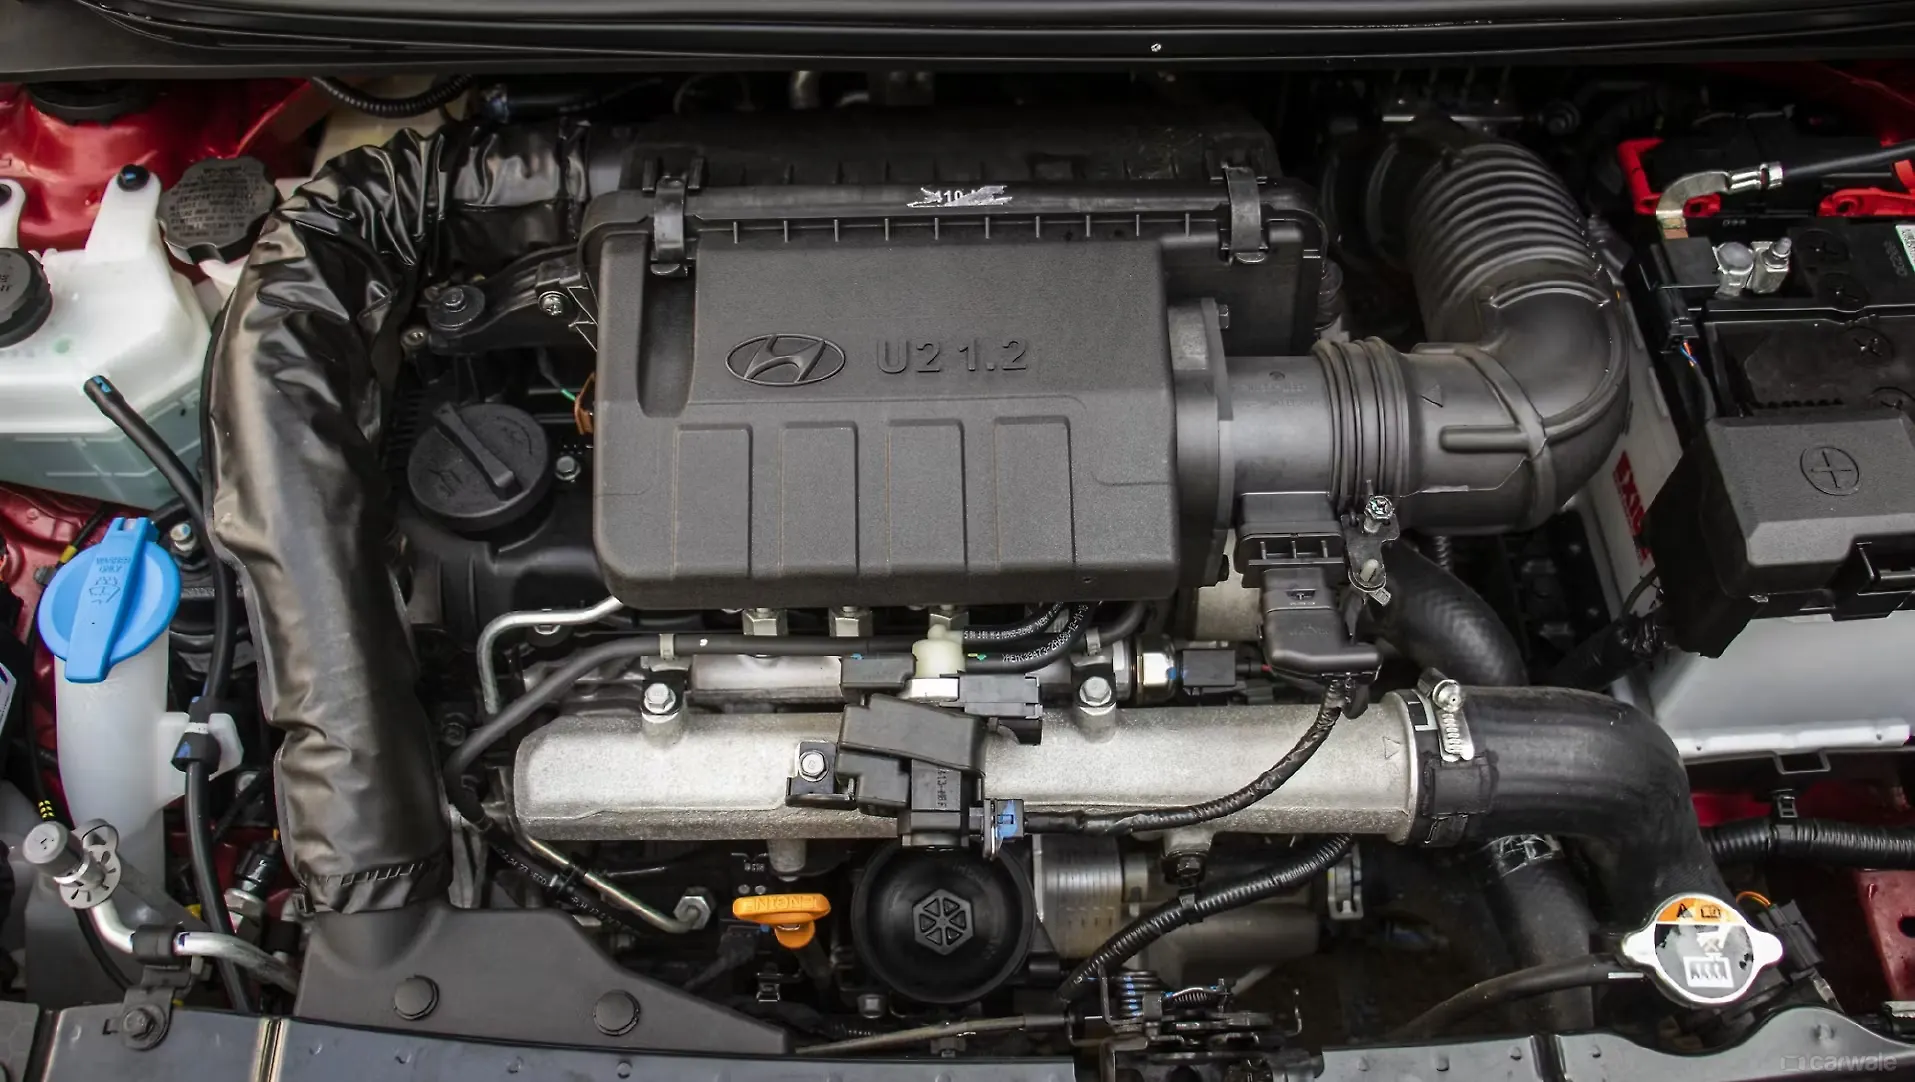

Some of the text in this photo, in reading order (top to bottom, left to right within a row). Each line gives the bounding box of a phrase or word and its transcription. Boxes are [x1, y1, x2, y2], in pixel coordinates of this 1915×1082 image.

[876, 338, 1028, 376] U2 1.2
[743, 896, 817, 913] ENGINE
